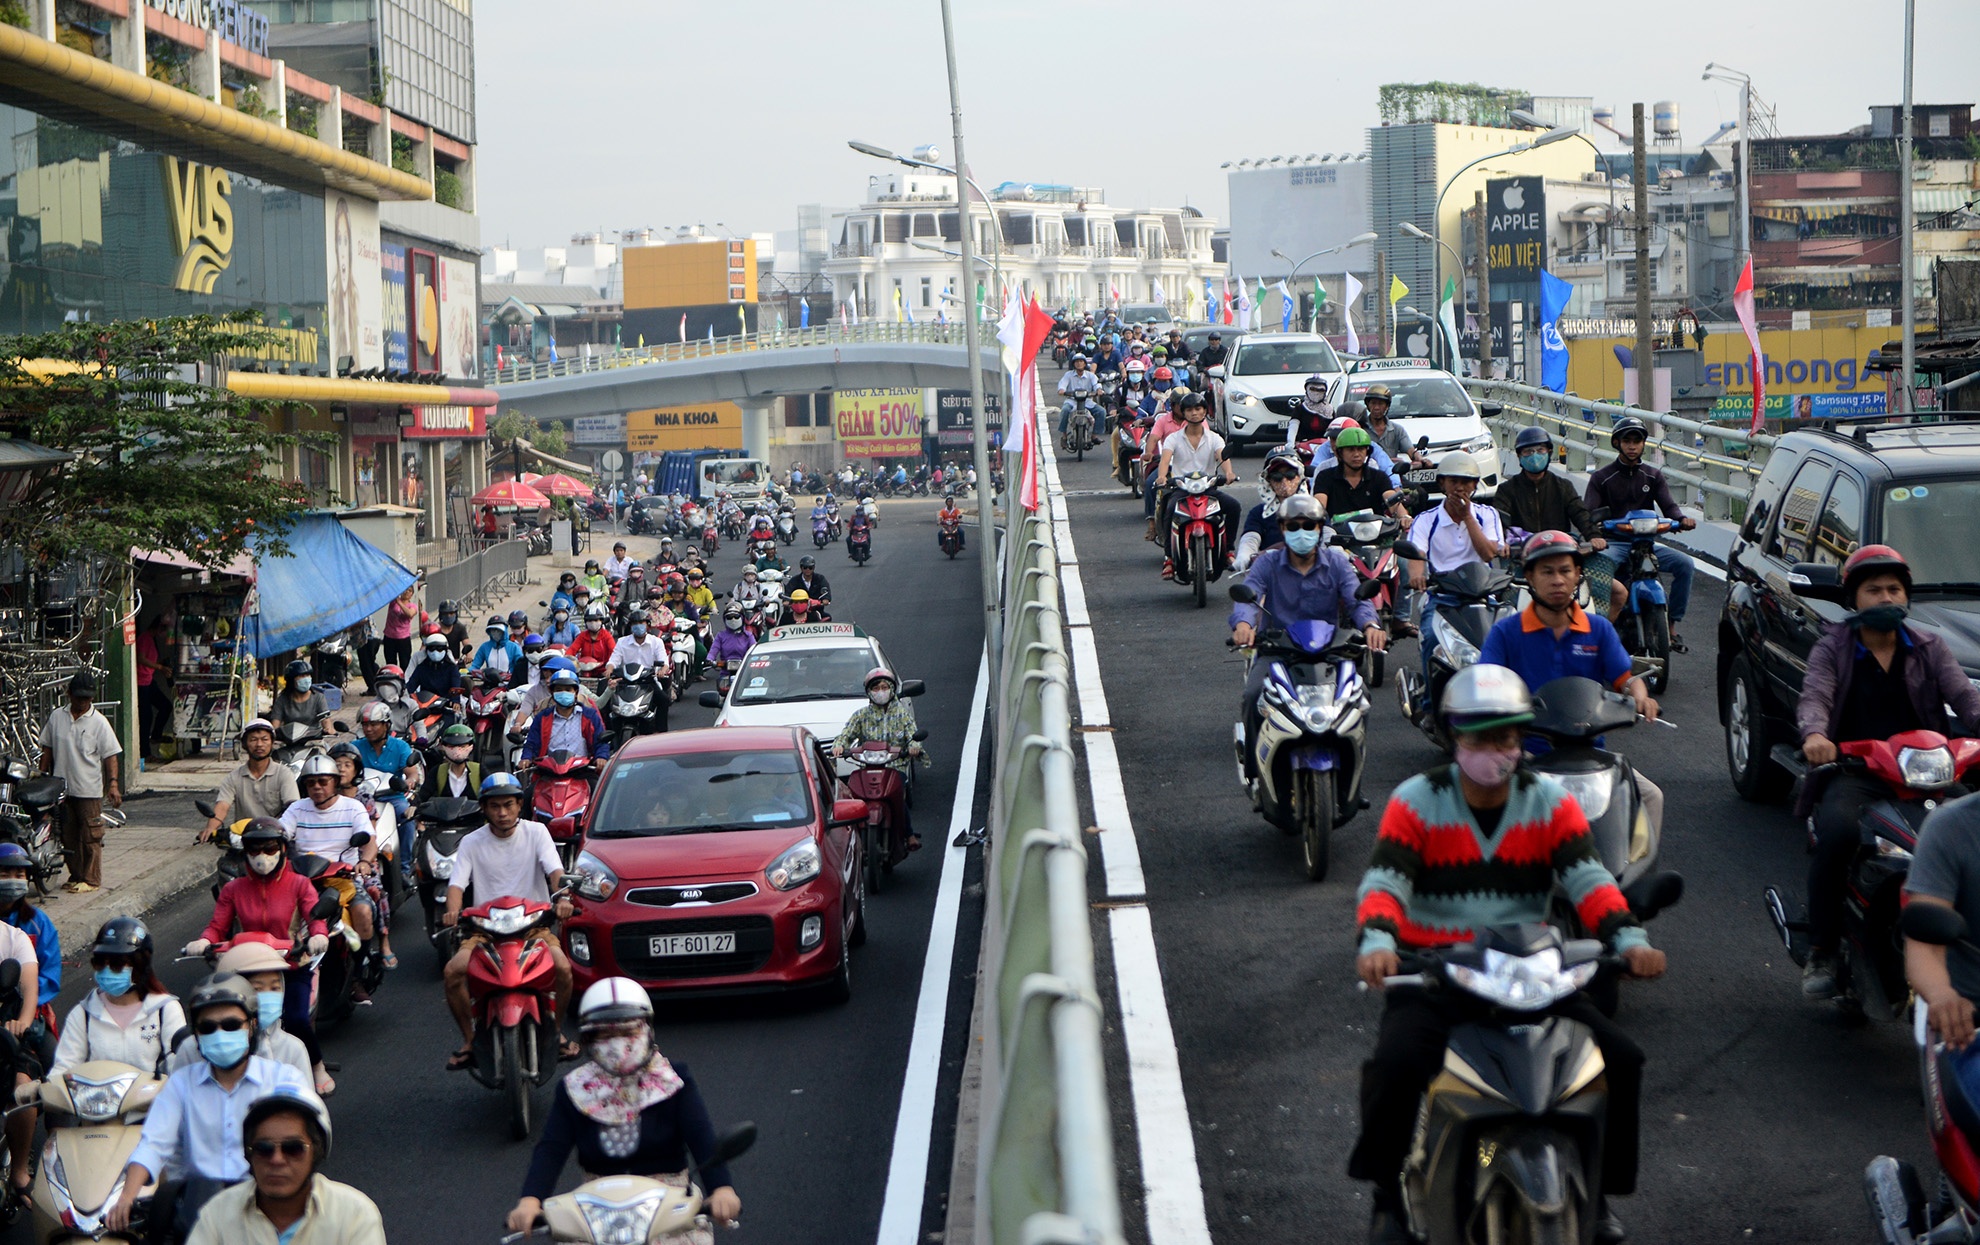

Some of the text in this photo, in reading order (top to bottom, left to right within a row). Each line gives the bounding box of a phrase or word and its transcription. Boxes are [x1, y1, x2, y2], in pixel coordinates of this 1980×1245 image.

[215, 0, 269, 57] CENTER
[166, 155, 233, 255] VUS
[1491, 213, 1539, 232] APPLE
[1489, 238, 1541, 272] SAO VIỆT
[942, 394, 961, 407] SIÊU
[1815, 395, 1858, 406] Samsung
[1860, 395, 1872, 404] J5
[424, 405, 466, 429] LOTTERIA
[1718, 410, 1735, 420] vàng
[1829, 406, 1849, 415] 100%
[655, 412, 719, 426] NHA KHOA
[838, 401, 921, 437] GIẢM 50%
[789, 624, 852, 635] VINASUN TAXI
[682, 890, 700, 898] KIA
[652, 934, 733, 954] 51F-601.27
